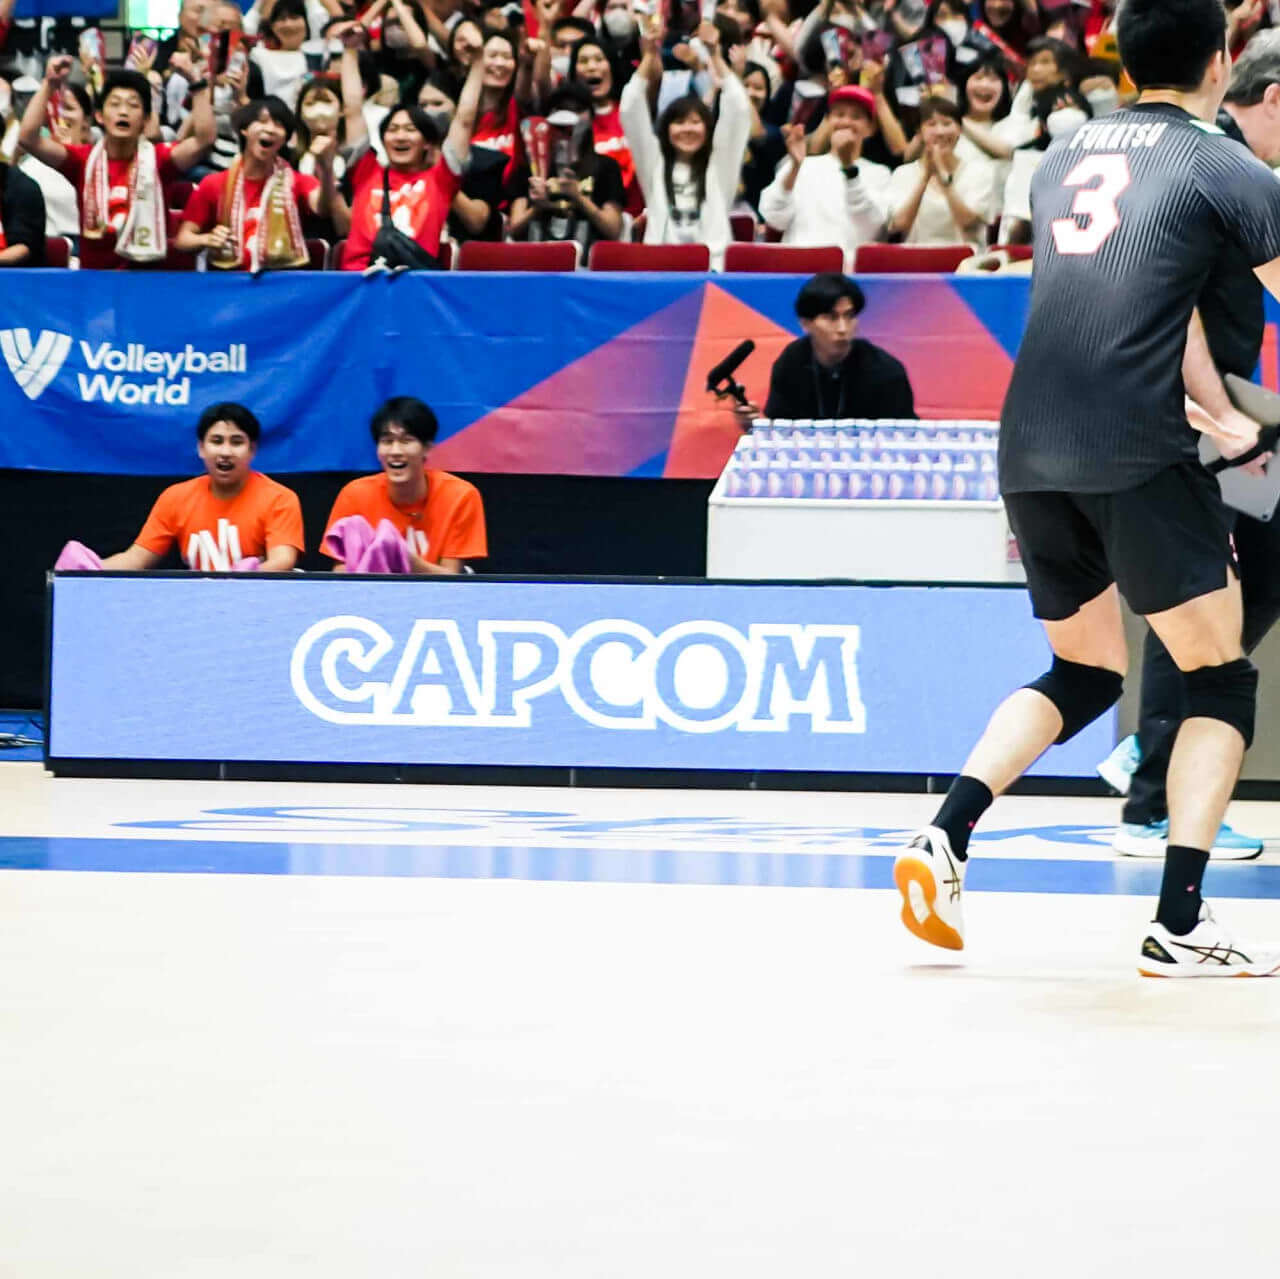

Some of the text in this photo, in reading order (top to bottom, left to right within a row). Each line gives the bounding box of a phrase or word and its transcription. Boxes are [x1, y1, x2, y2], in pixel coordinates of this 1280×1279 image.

[1051, 152, 1132, 256] 3
[77, 374, 191, 407] World
[80, 340, 247, 376] Volleyball
[290, 614, 866, 734] CAPCOM
